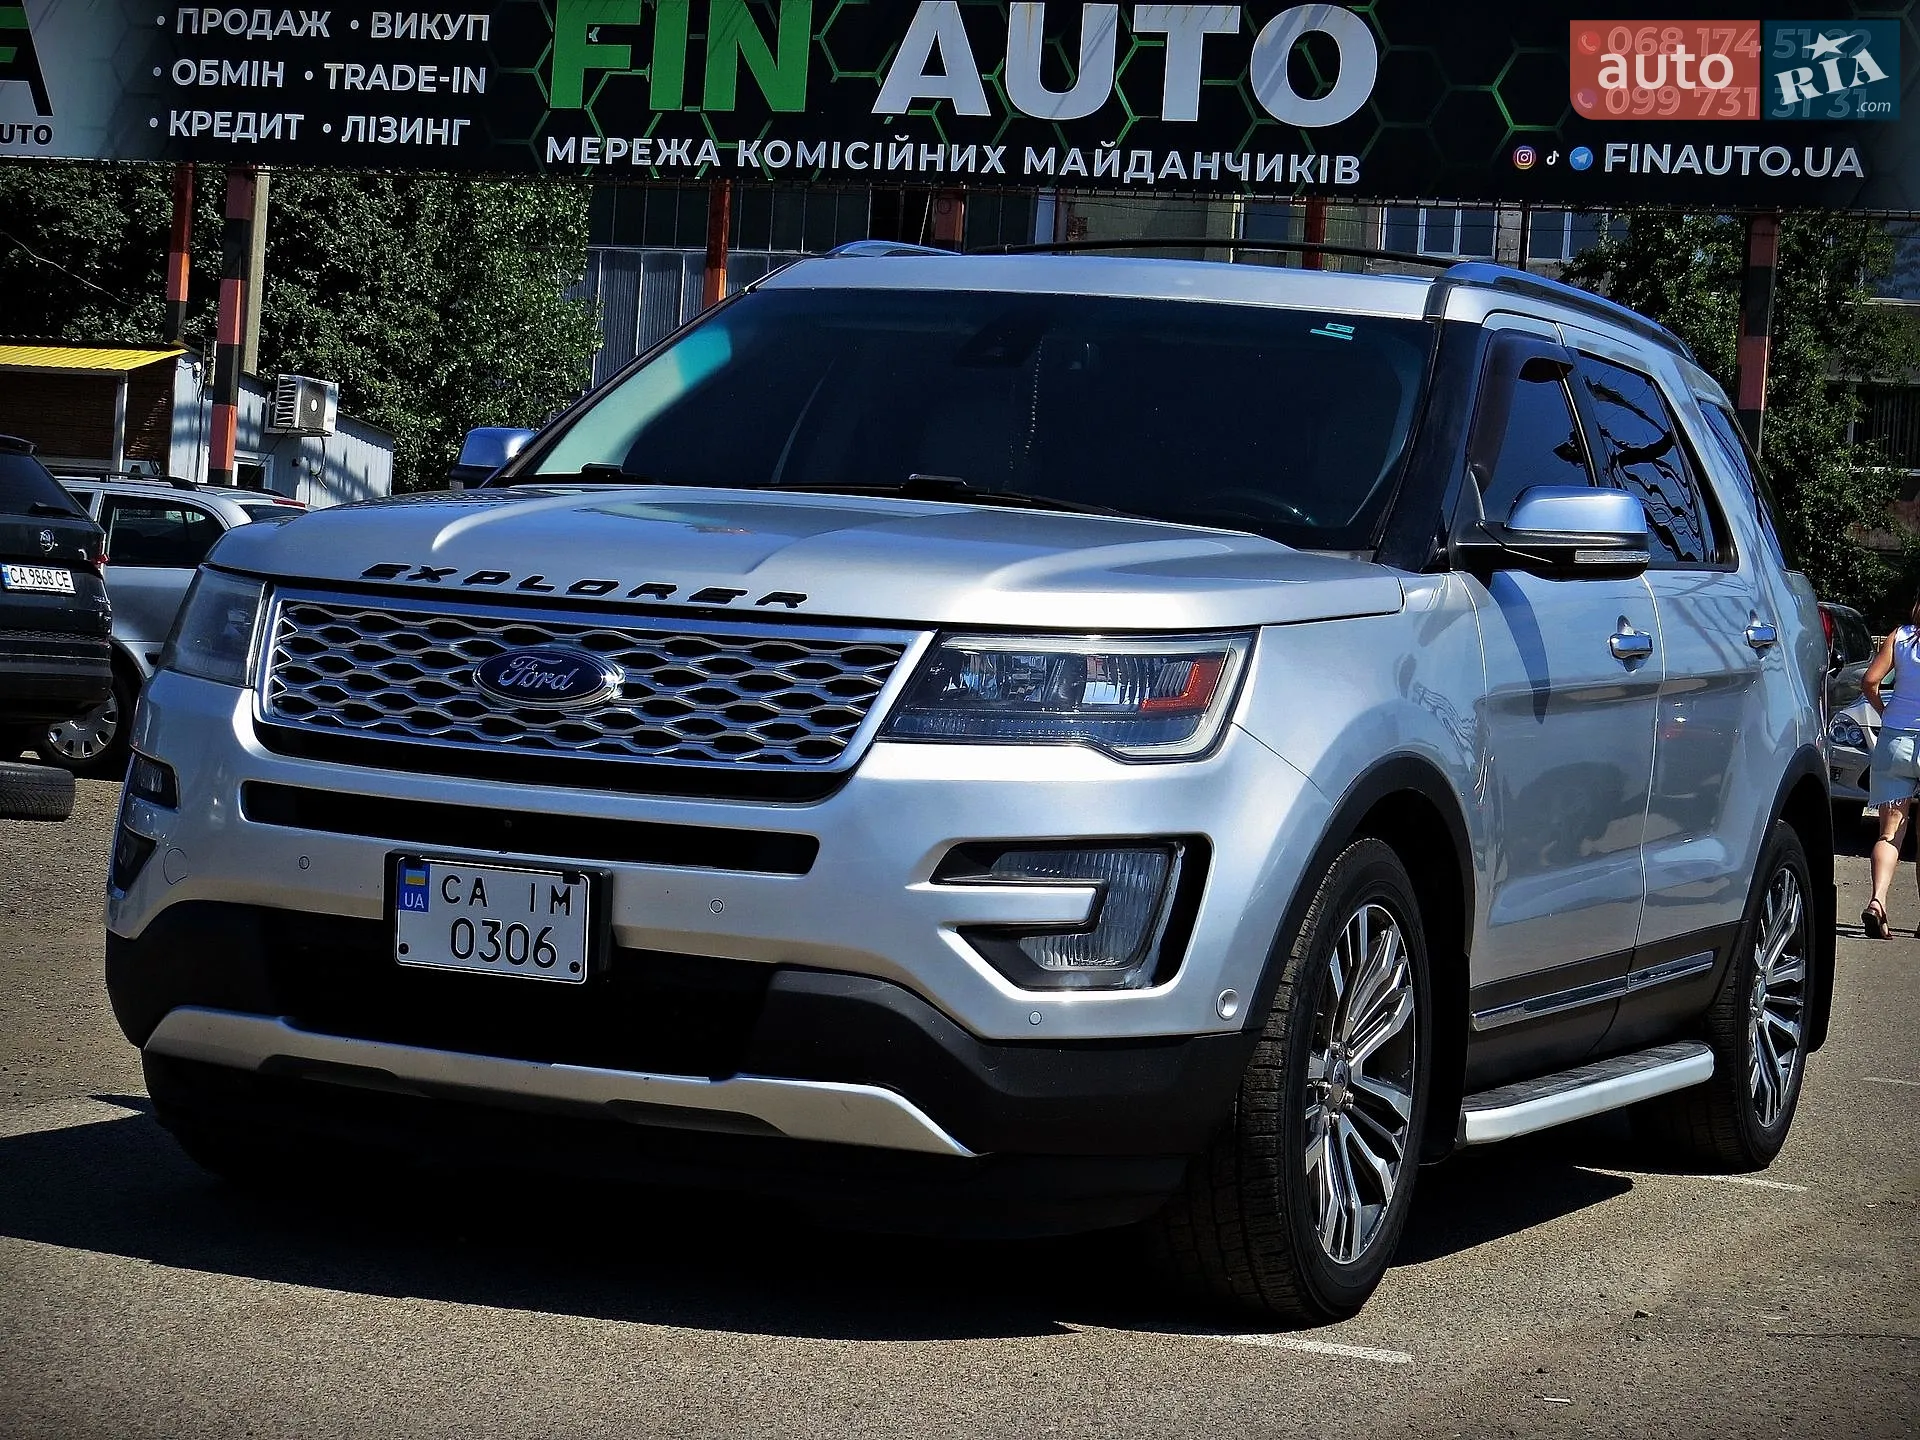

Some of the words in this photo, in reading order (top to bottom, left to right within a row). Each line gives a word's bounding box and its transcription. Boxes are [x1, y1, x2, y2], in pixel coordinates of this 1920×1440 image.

[176, 8, 331, 40] ПРОДАЖ
[371, 12, 490, 42] ВИКУП
[172, 58, 284, 88] ОБМІН
[324, 63, 487, 95] TRADE-IN
[549, 0, 809, 112] FIN
[871, 0, 1378, 128] AUTO
[168, 110, 304, 143] КРЕДИТ
[341, 116, 471, 146] ЛІЗИНГ
[546, 136, 721, 167] МЕРЕЖА
[737, 135, 1008, 174] КОМІСІЙНИХ
[1023, 140, 1361, 185] МАЙДАНЧИКІВ
[1604, 143, 1865, 178] FINAUTO.UA
[10, 567, 28, 585] CA
[55, 571, 71, 588] CE
[360, 562, 808, 609] EXPLORER
[499, 655, 577, 692] Ford
[404, 892, 425, 909] UA
[441, 874, 488, 908] CA
[529, 882, 572, 916] IM
[450, 916, 558, 969] 0306
